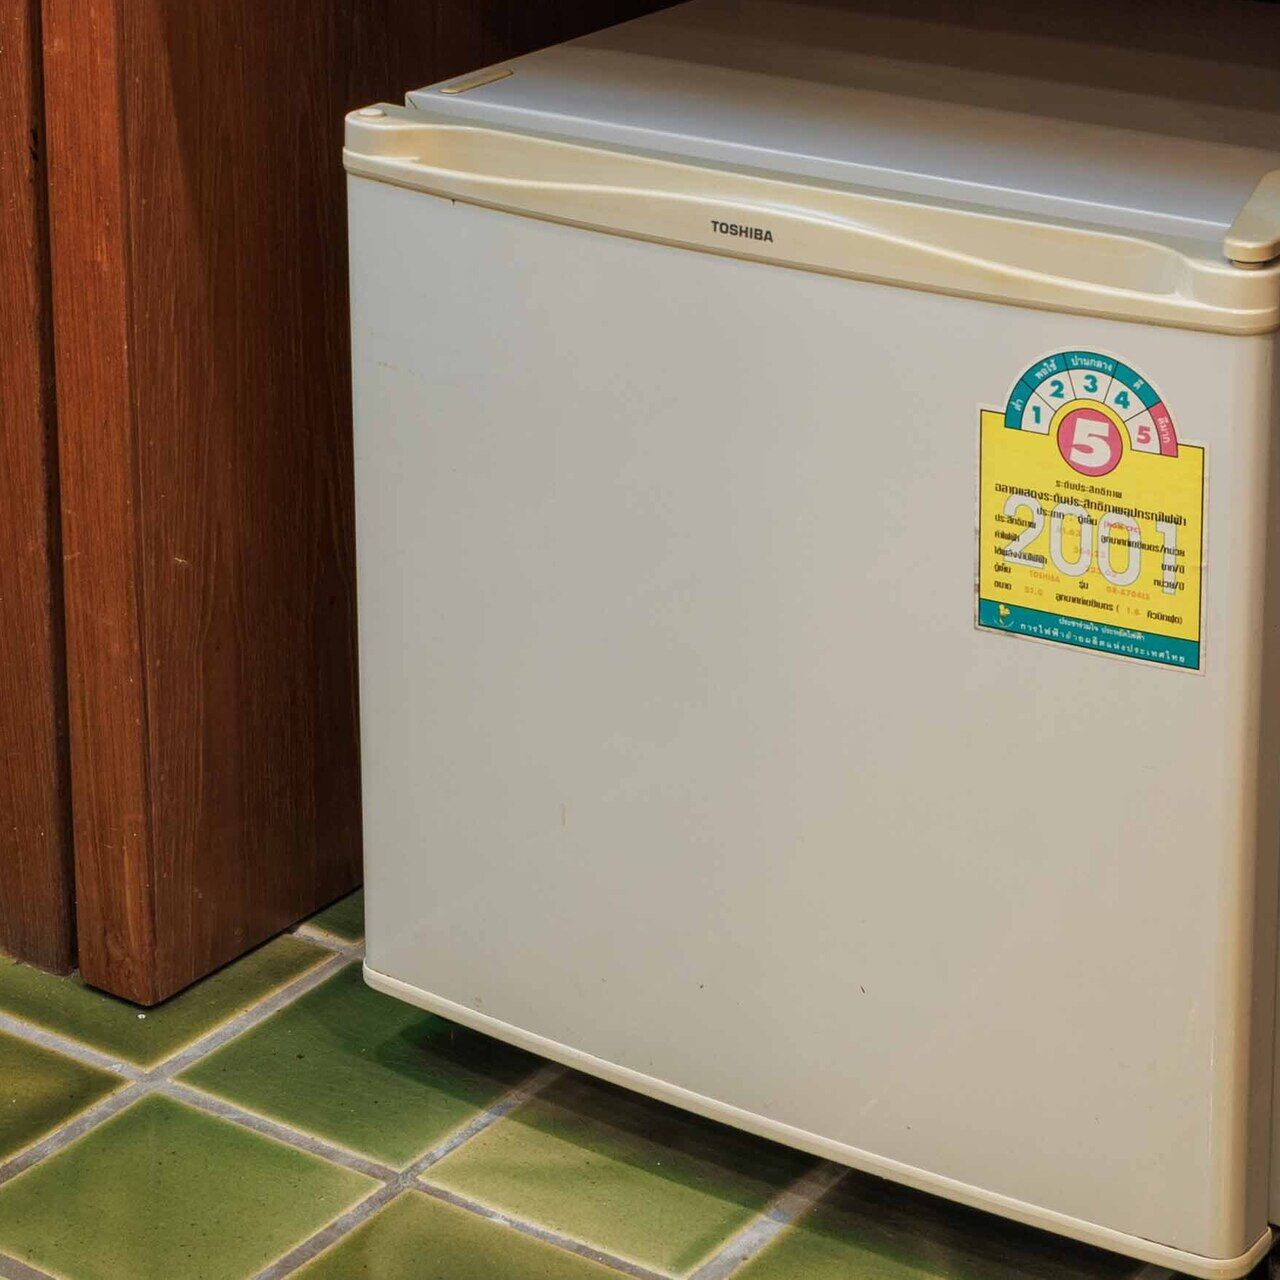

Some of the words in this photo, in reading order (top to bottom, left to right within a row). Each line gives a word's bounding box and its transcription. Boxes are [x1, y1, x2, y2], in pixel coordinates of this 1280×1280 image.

[711, 220, 773, 243] TOSHIBA
[1071, 355, 1113, 372] ปานกลาง
[1032, 406, 1040, 423] 1
[1050, 380, 1064, 398] 2
[1083, 375, 1097, 392] 3
[1115, 391, 1130, 409] 4
[1138, 426, 1150, 444] 5
[1069, 418, 1111, 468] 5
[1002, 493, 1181, 596] 2001
